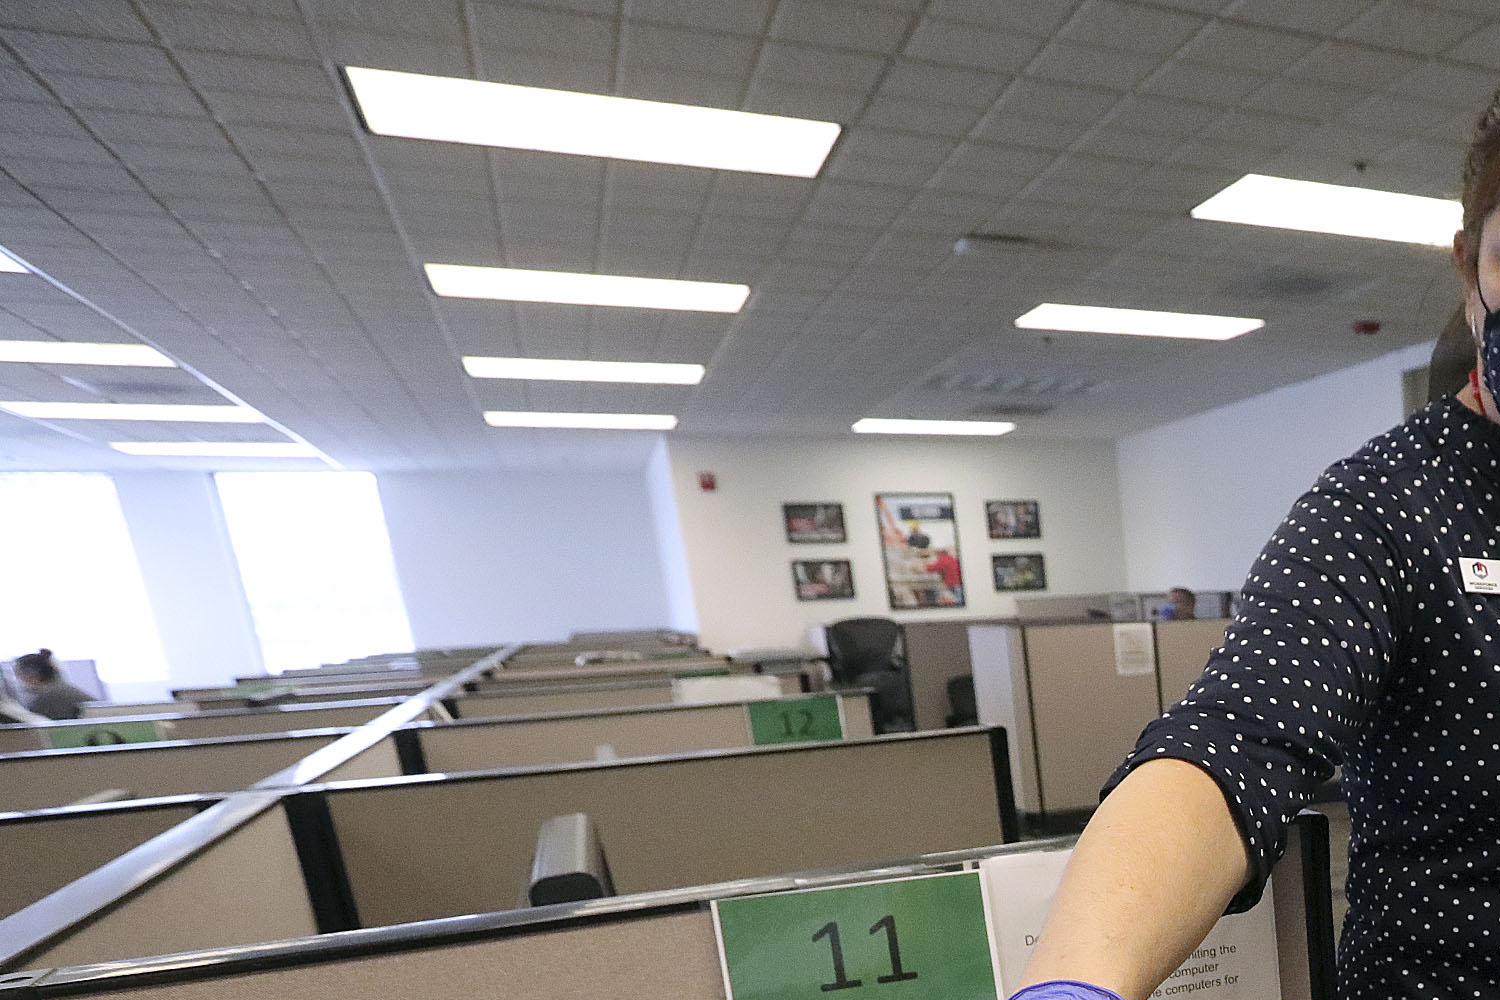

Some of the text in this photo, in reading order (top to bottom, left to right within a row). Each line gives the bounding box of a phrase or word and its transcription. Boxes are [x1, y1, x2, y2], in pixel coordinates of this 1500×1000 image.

[781, 708, 816, 738] 12
[811, 915, 918, 992] 11
[1219, 944, 1237, 955] the
[1165, 978, 1221, 994] computers
[1224, 974, 1239, 985] for
